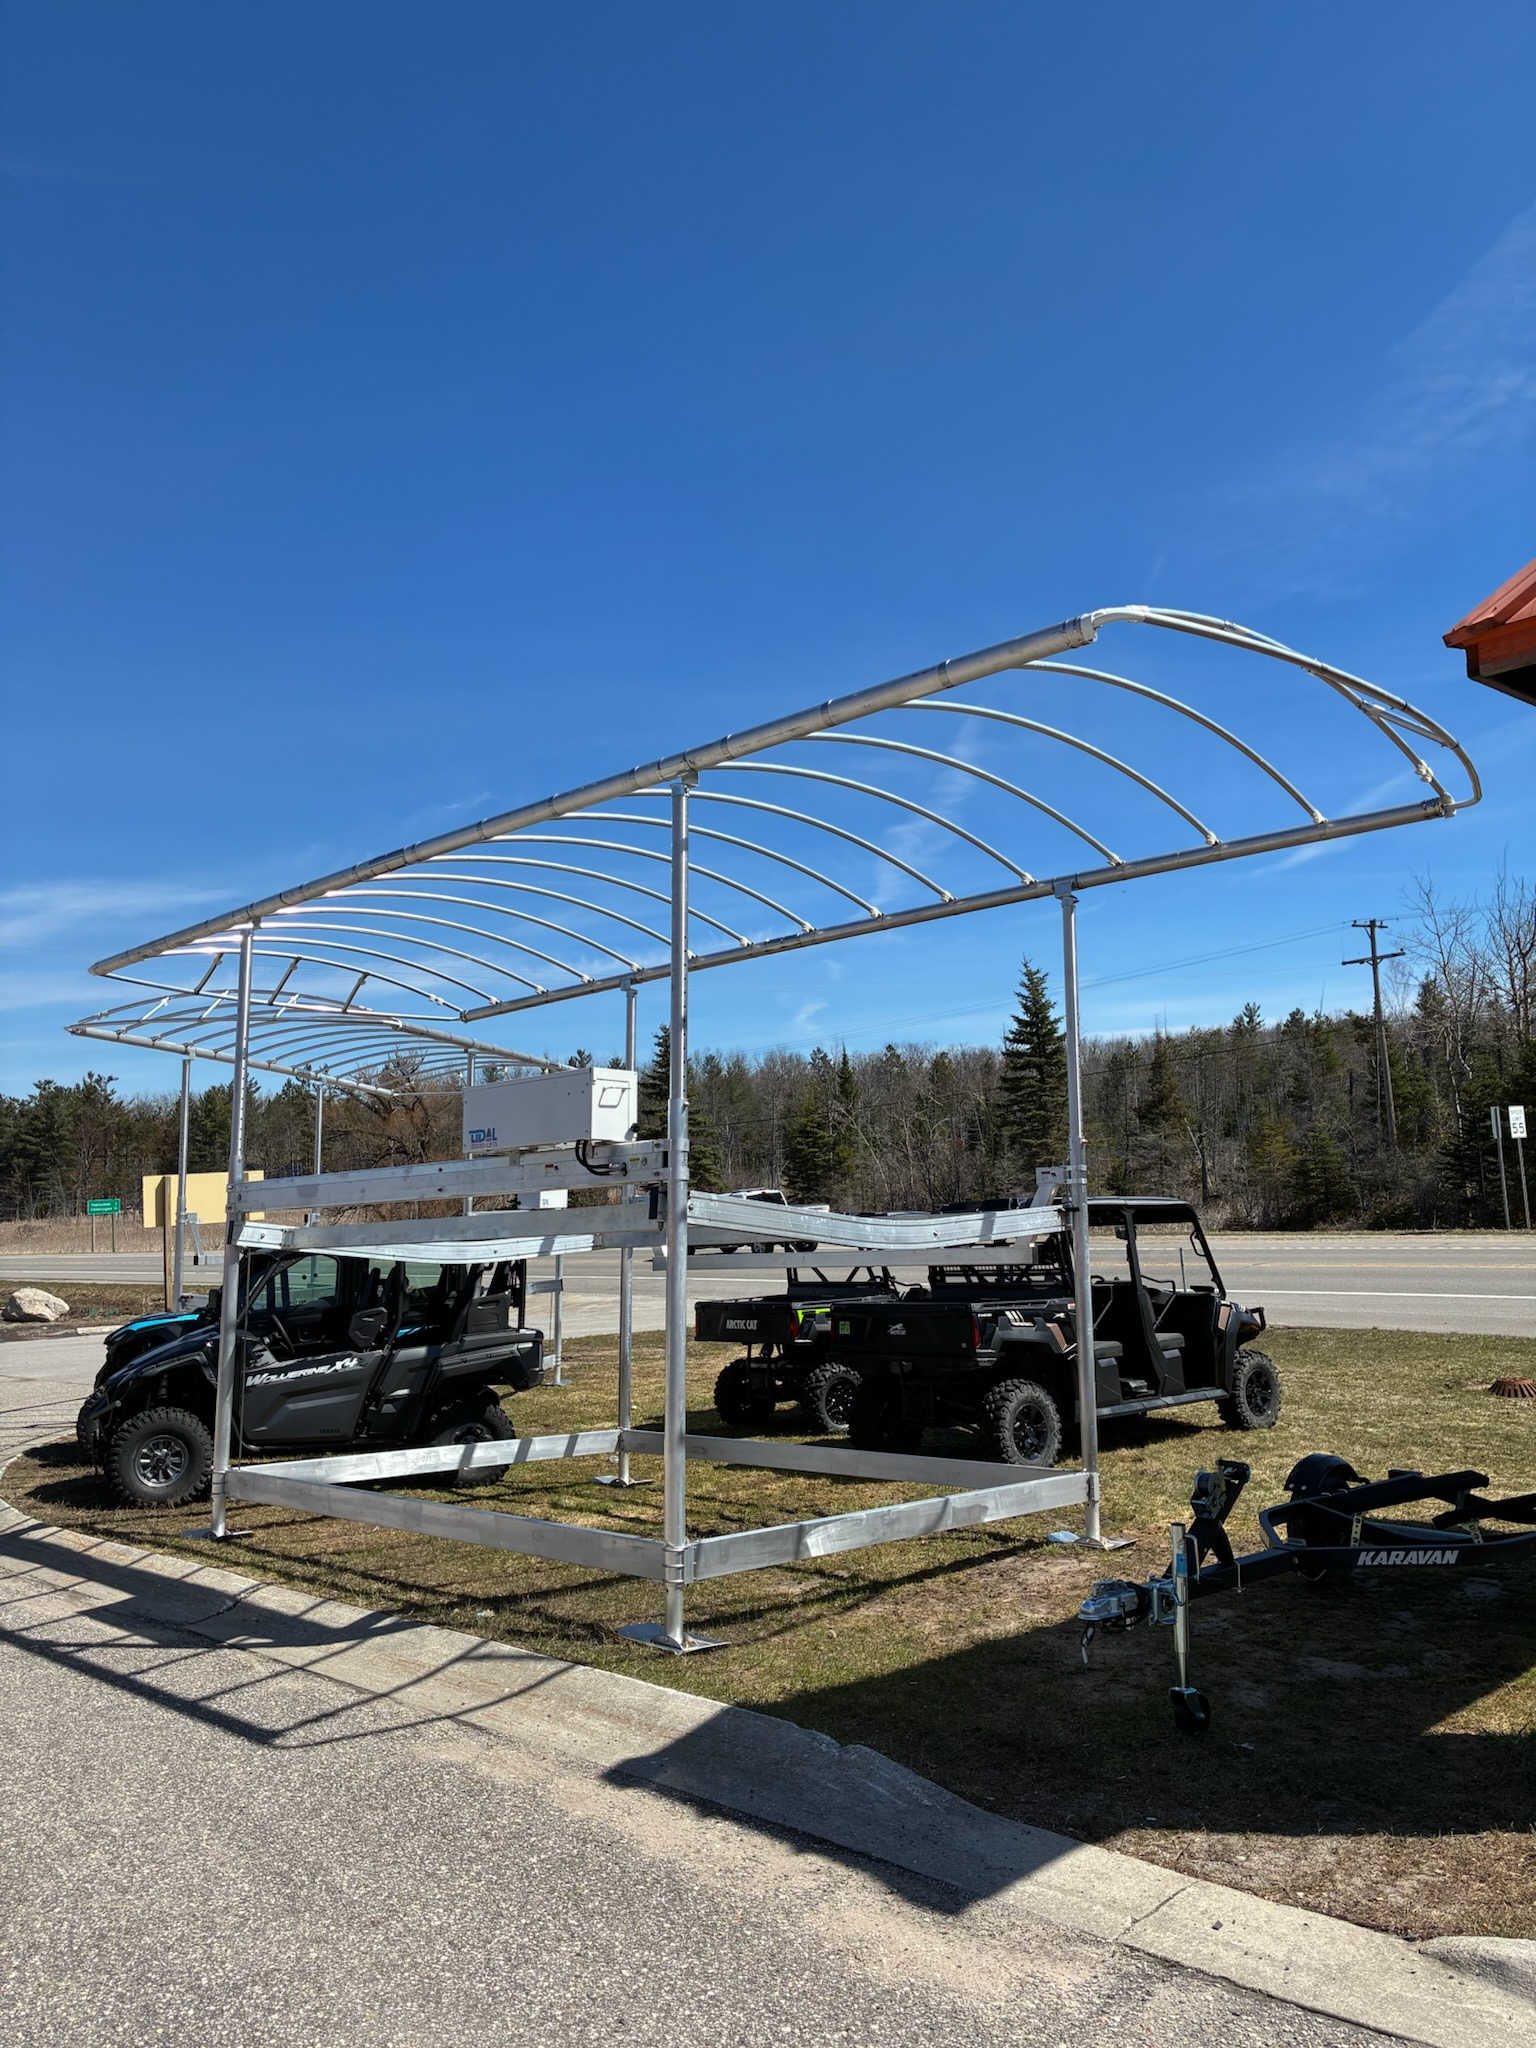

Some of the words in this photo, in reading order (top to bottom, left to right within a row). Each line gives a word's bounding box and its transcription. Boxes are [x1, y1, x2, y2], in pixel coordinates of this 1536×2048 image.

[469, 1127, 498, 1143] TIDAL
[1512, 1122, 1525, 1134] 55
[726, 1319, 746, 1330] ARCTIC
[746, 1320, 758, 1330] CAT
[324, 1358, 359, 1375] X4
[1357, 1550, 1459, 1566] KARAVAN
